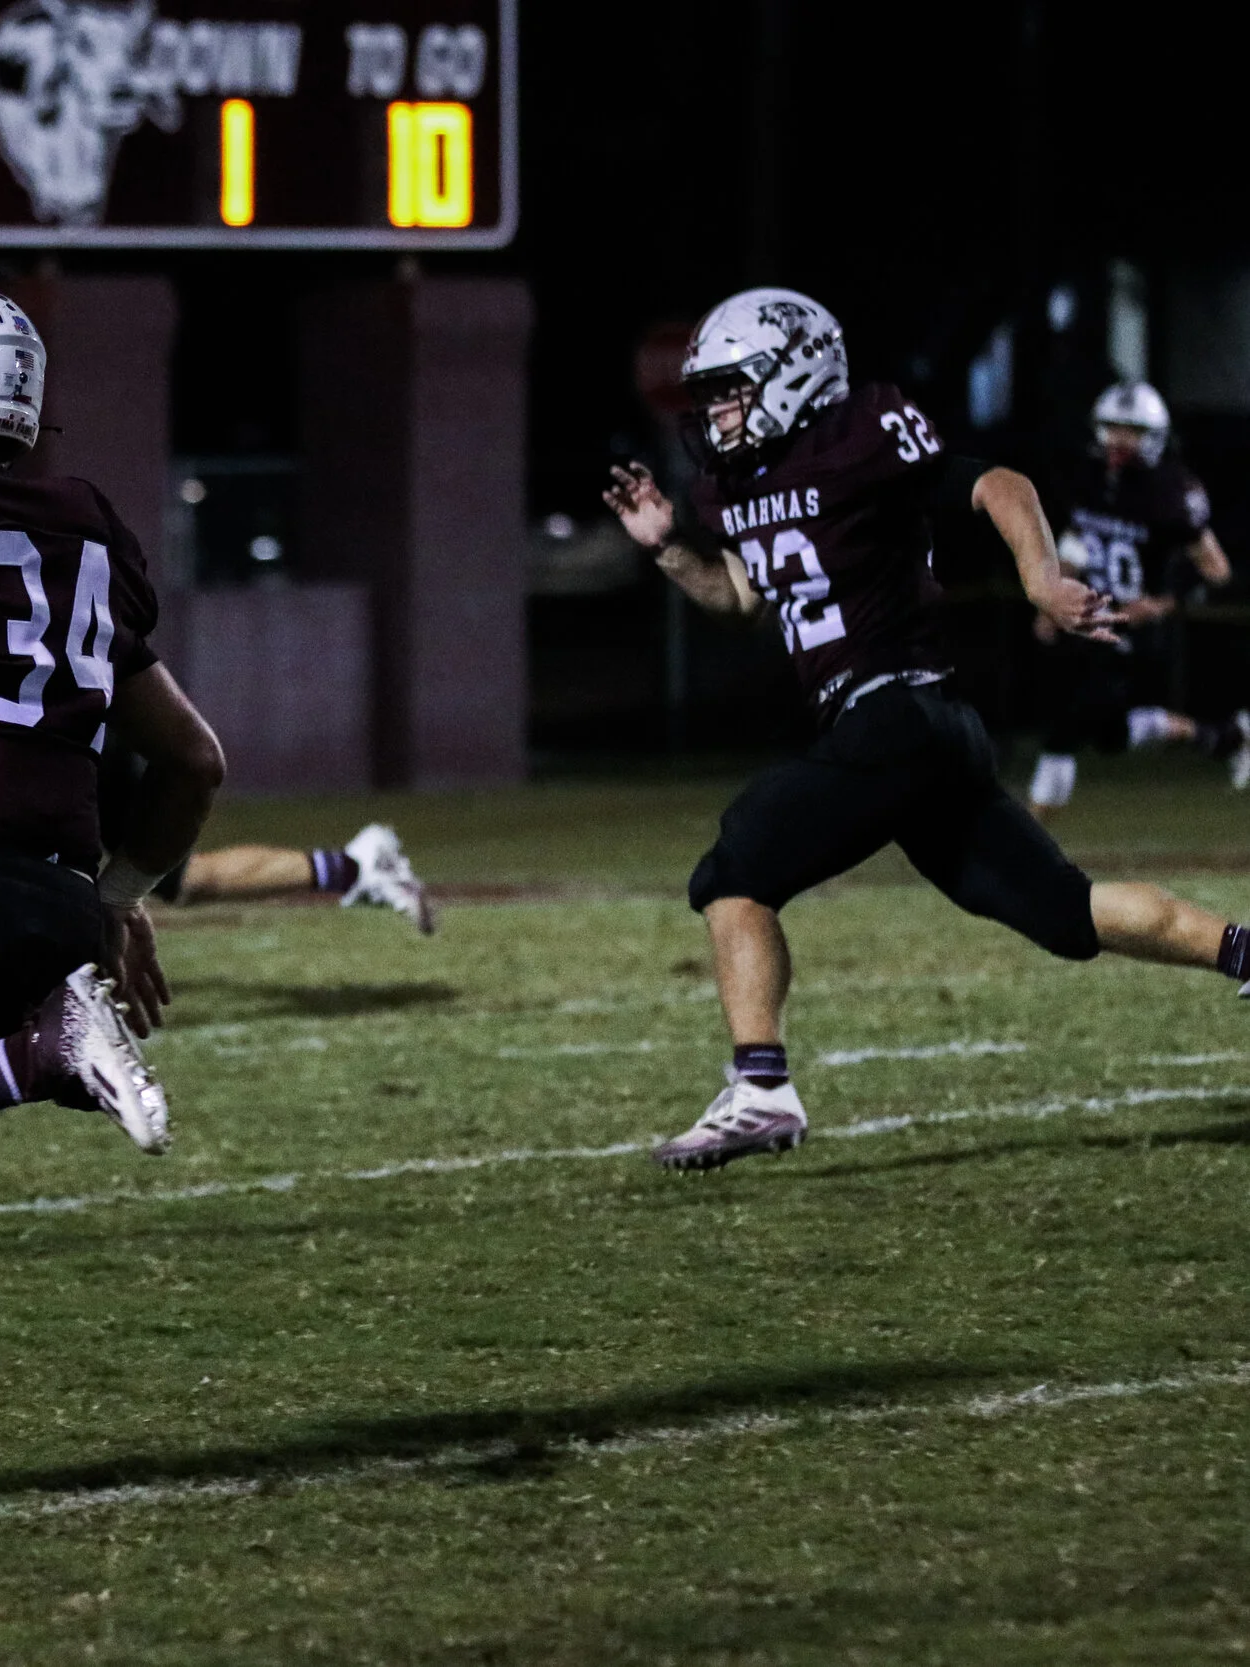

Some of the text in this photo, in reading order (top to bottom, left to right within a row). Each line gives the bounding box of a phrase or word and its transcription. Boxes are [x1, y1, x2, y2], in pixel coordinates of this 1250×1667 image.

[345, 23, 487, 97] TO GO
[221, 98, 255, 226] 1
[387, 101, 473, 227] 10
[881, 406, 939, 464] 32
[721, 487, 820, 536] BRAHMAS
